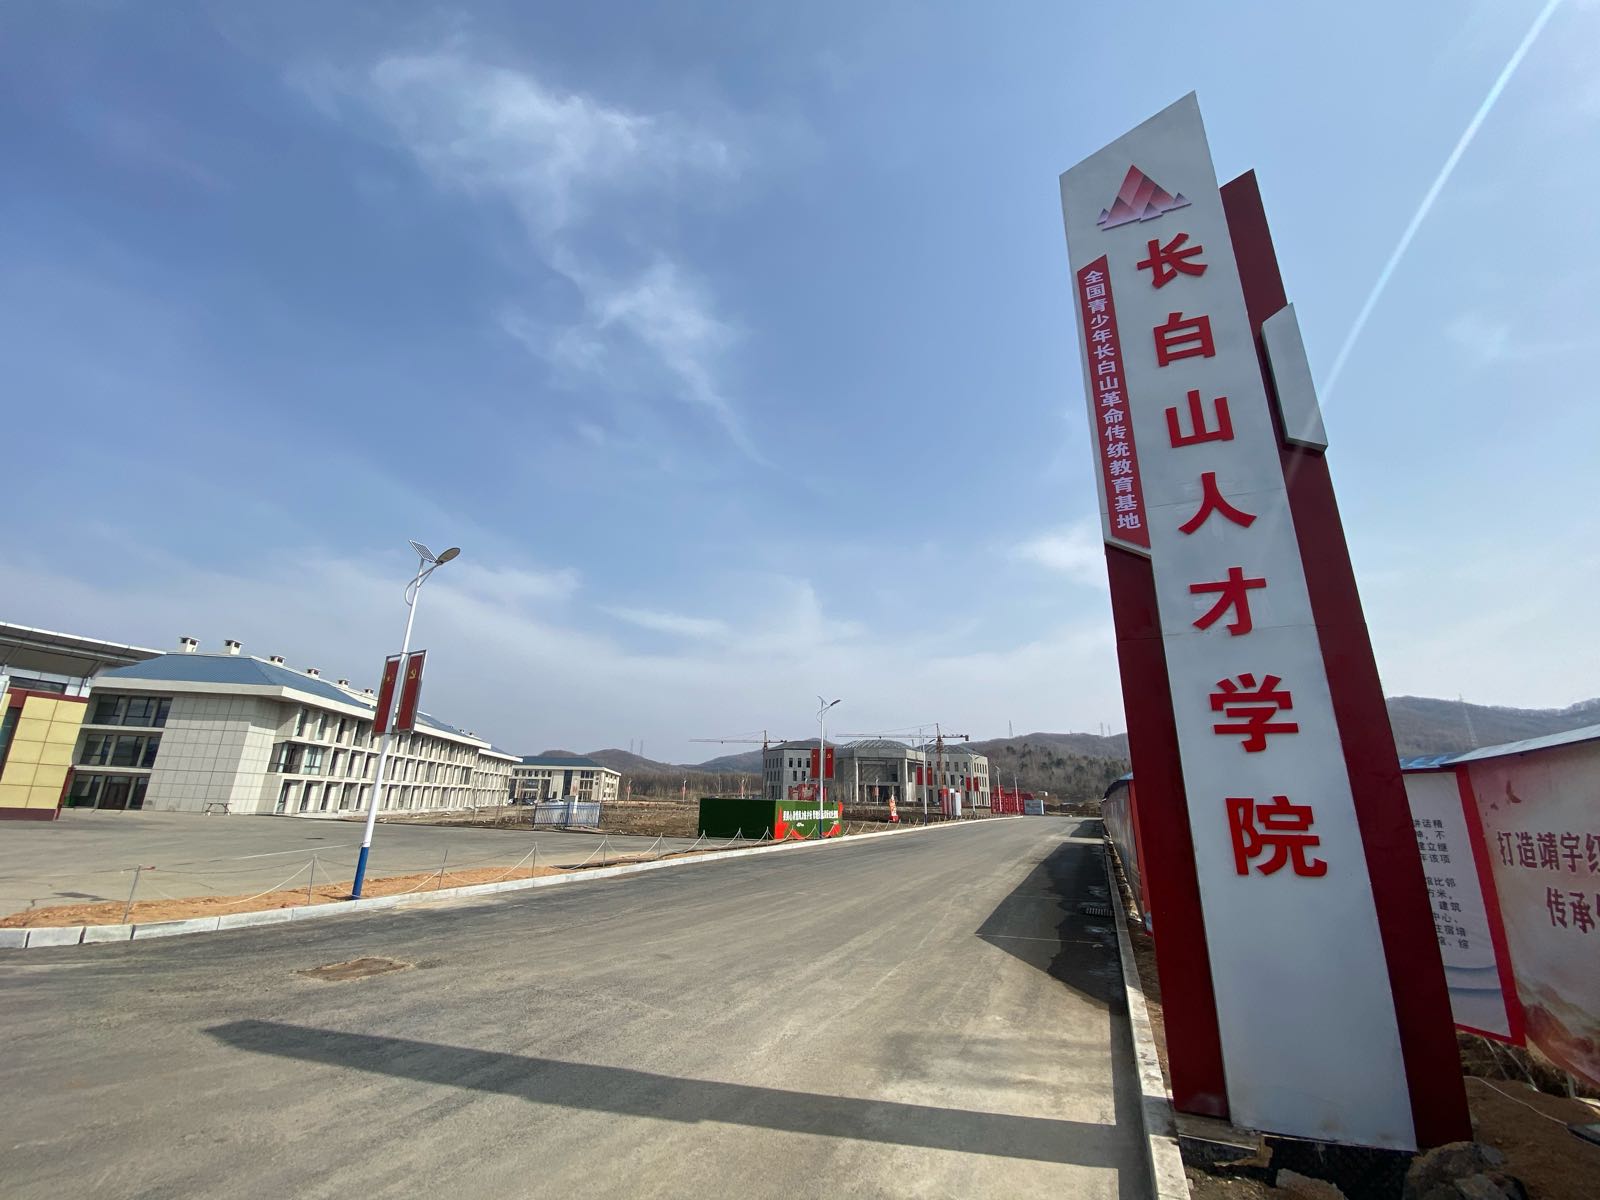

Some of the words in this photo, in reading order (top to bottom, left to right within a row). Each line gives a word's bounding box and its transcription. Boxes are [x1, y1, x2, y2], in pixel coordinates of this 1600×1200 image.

[1083, 269, 1142, 531] 全国青少年长白山革命传统教育基地
[1137, 232, 1327, 877] 长白山人才学院
[1546, 886, 1600, 934] 传承
